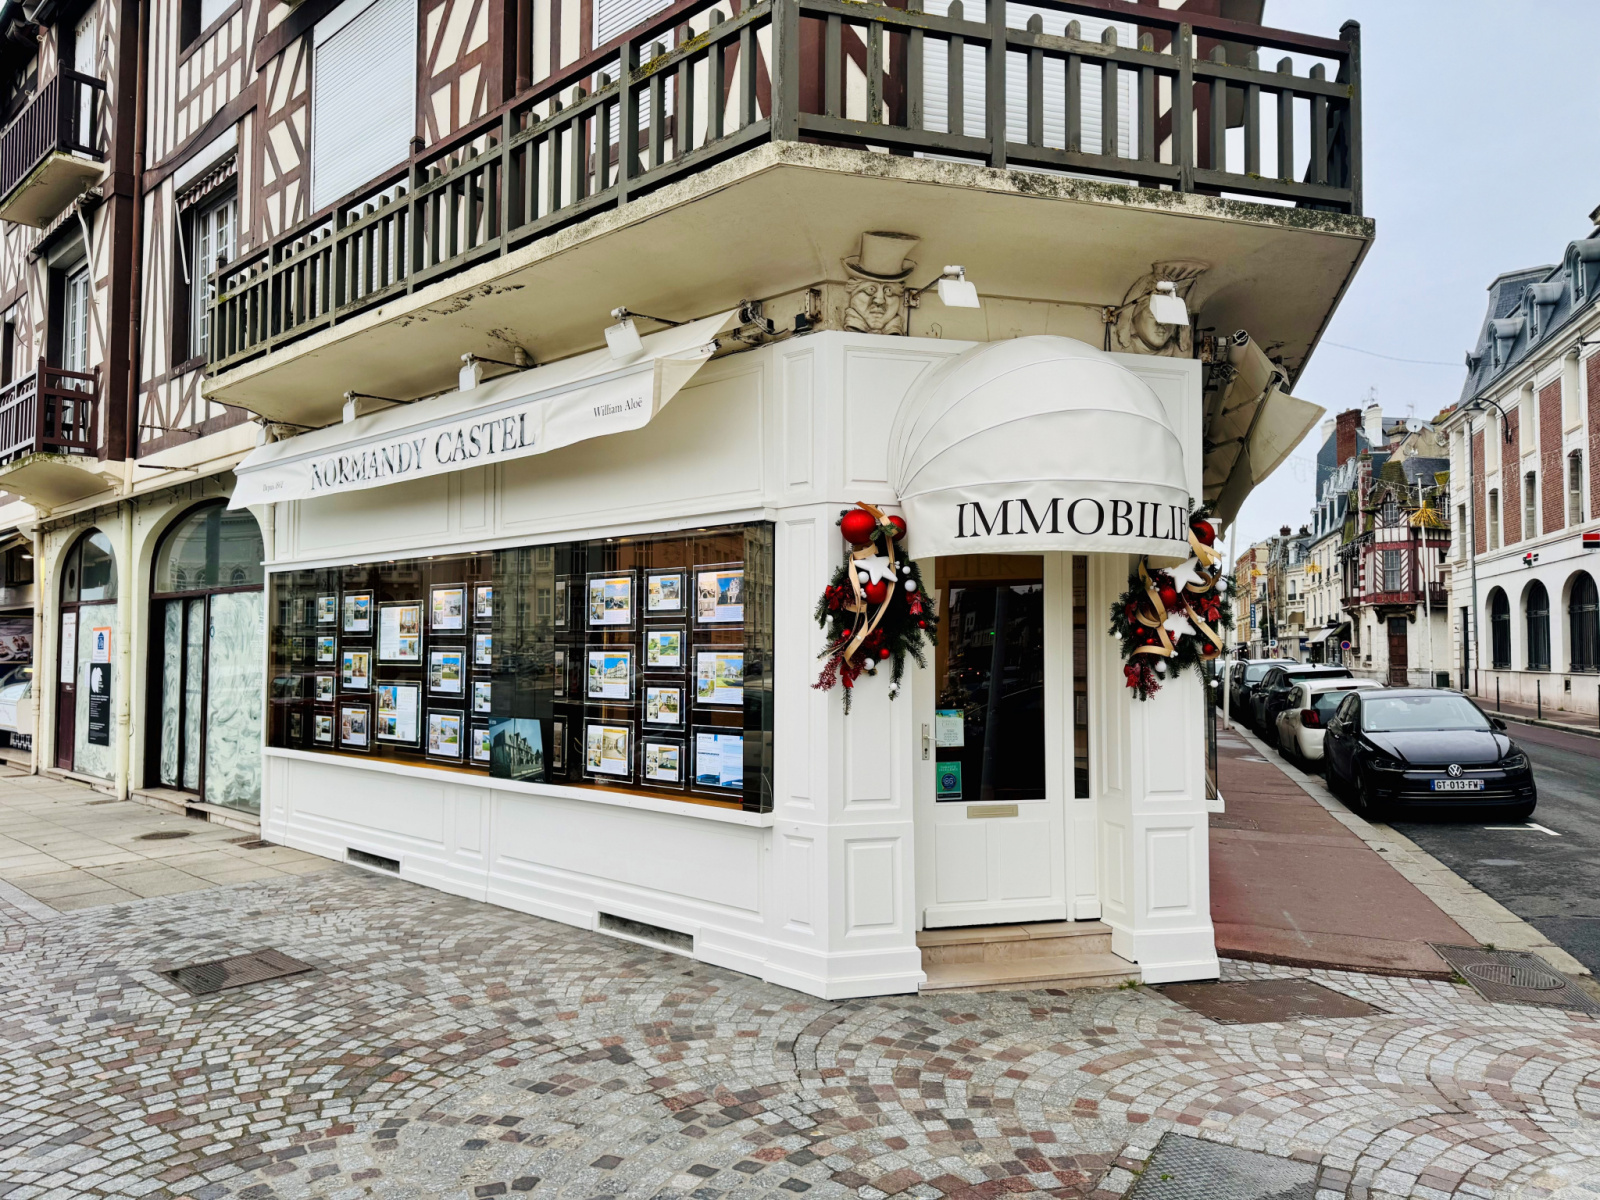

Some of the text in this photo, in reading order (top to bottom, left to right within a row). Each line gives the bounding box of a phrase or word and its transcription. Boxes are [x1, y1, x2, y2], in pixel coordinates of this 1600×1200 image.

[593, 404, 623, 417] William
[311, 412, 536, 490] NORMANDY CASTEL
[954, 498, 1189, 543] IMMOBILIE
